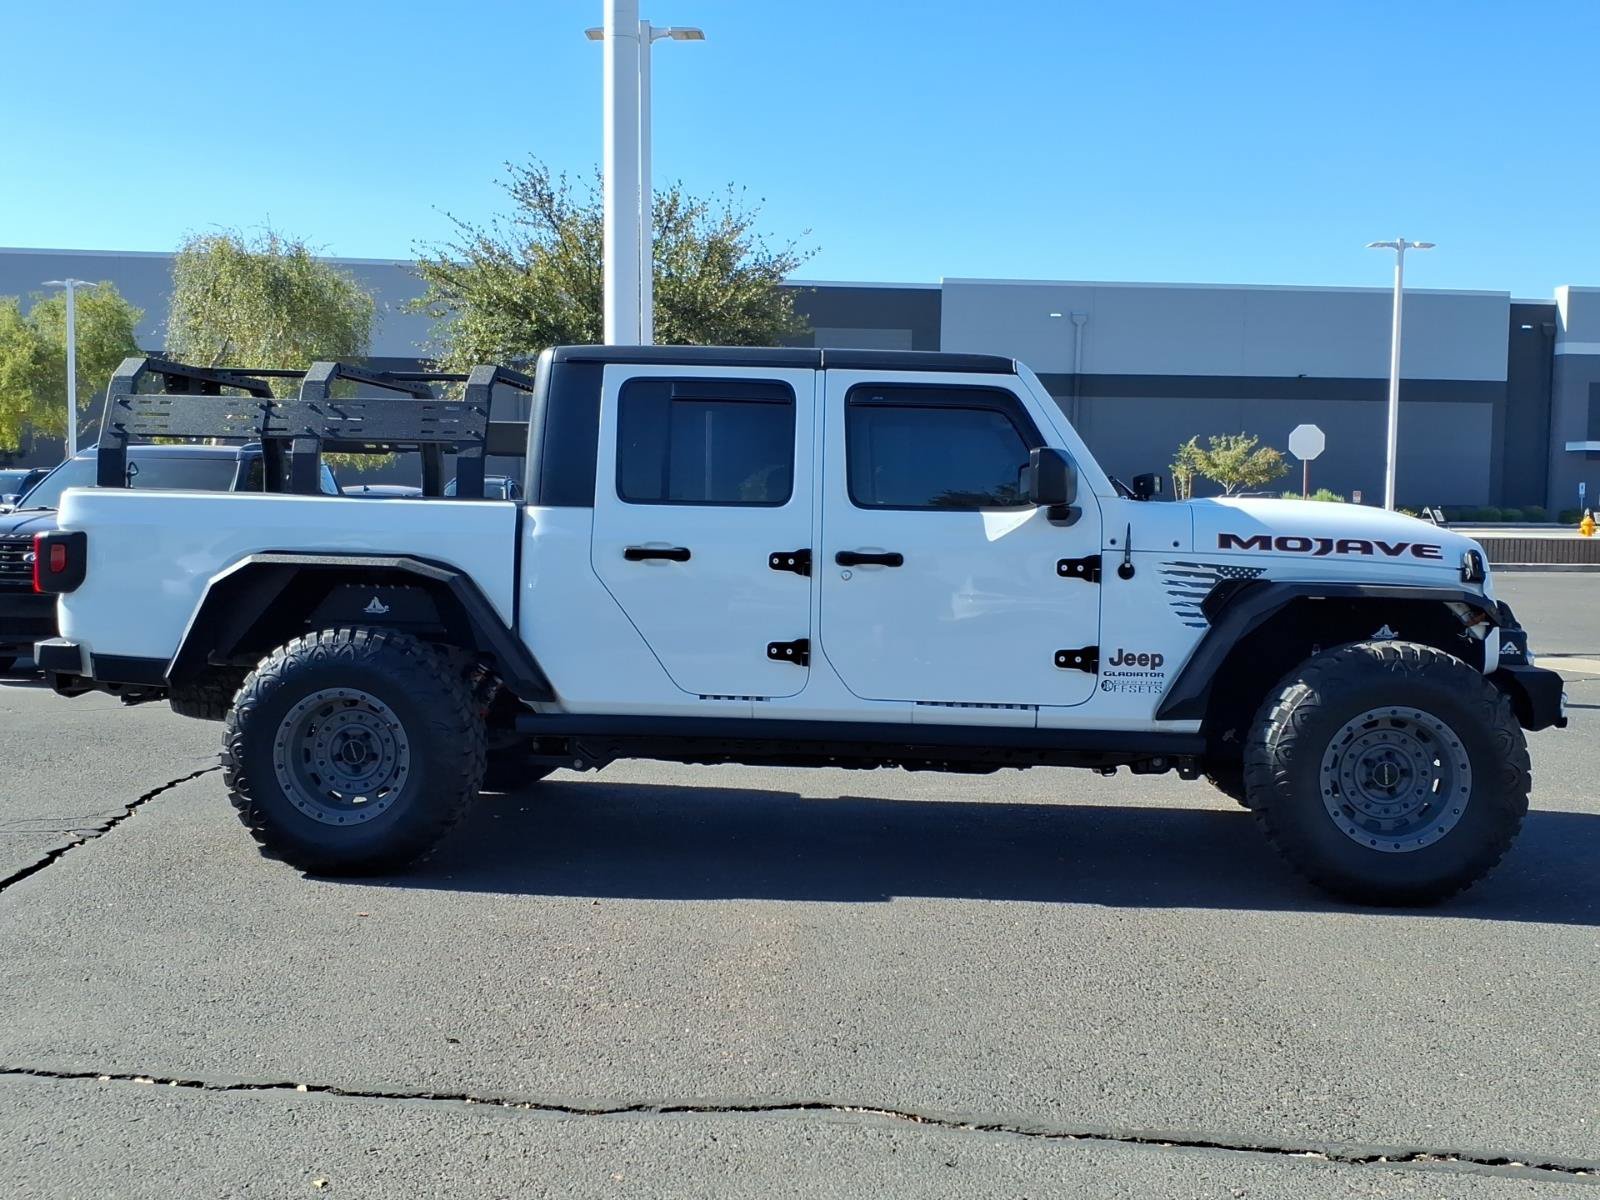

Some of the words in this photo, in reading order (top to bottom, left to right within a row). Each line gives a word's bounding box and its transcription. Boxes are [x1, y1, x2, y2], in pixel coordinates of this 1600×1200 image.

[1217, 533, 1444, 560] MOJAVE
[1108, 648, 1164, 671] Jeep
[1103, 670, 1165, 678] GLADIATOR
